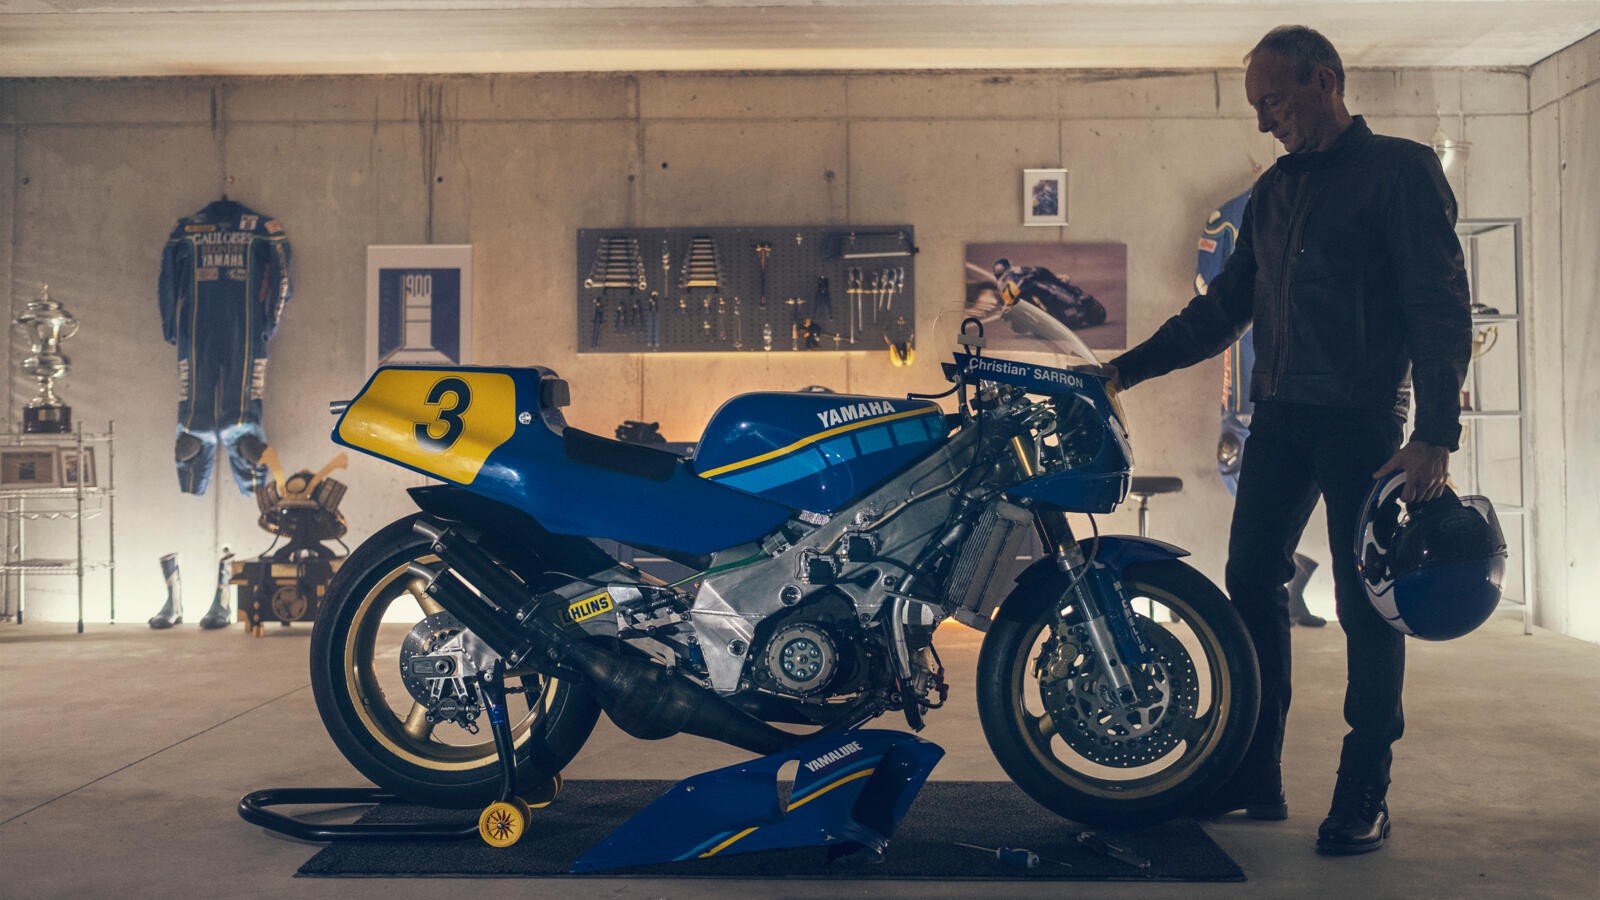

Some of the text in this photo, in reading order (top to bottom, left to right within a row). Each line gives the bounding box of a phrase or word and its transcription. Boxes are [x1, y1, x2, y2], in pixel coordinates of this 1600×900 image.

[201, 254, 244, 267] YAMAHA
[969, 357, 1083, 388] Christian SARRON
[413, 376, 473, 453] 3
[816, 400, 896, 428] YAMAHA
[804, 740, 863, 772] YAMALUBE
